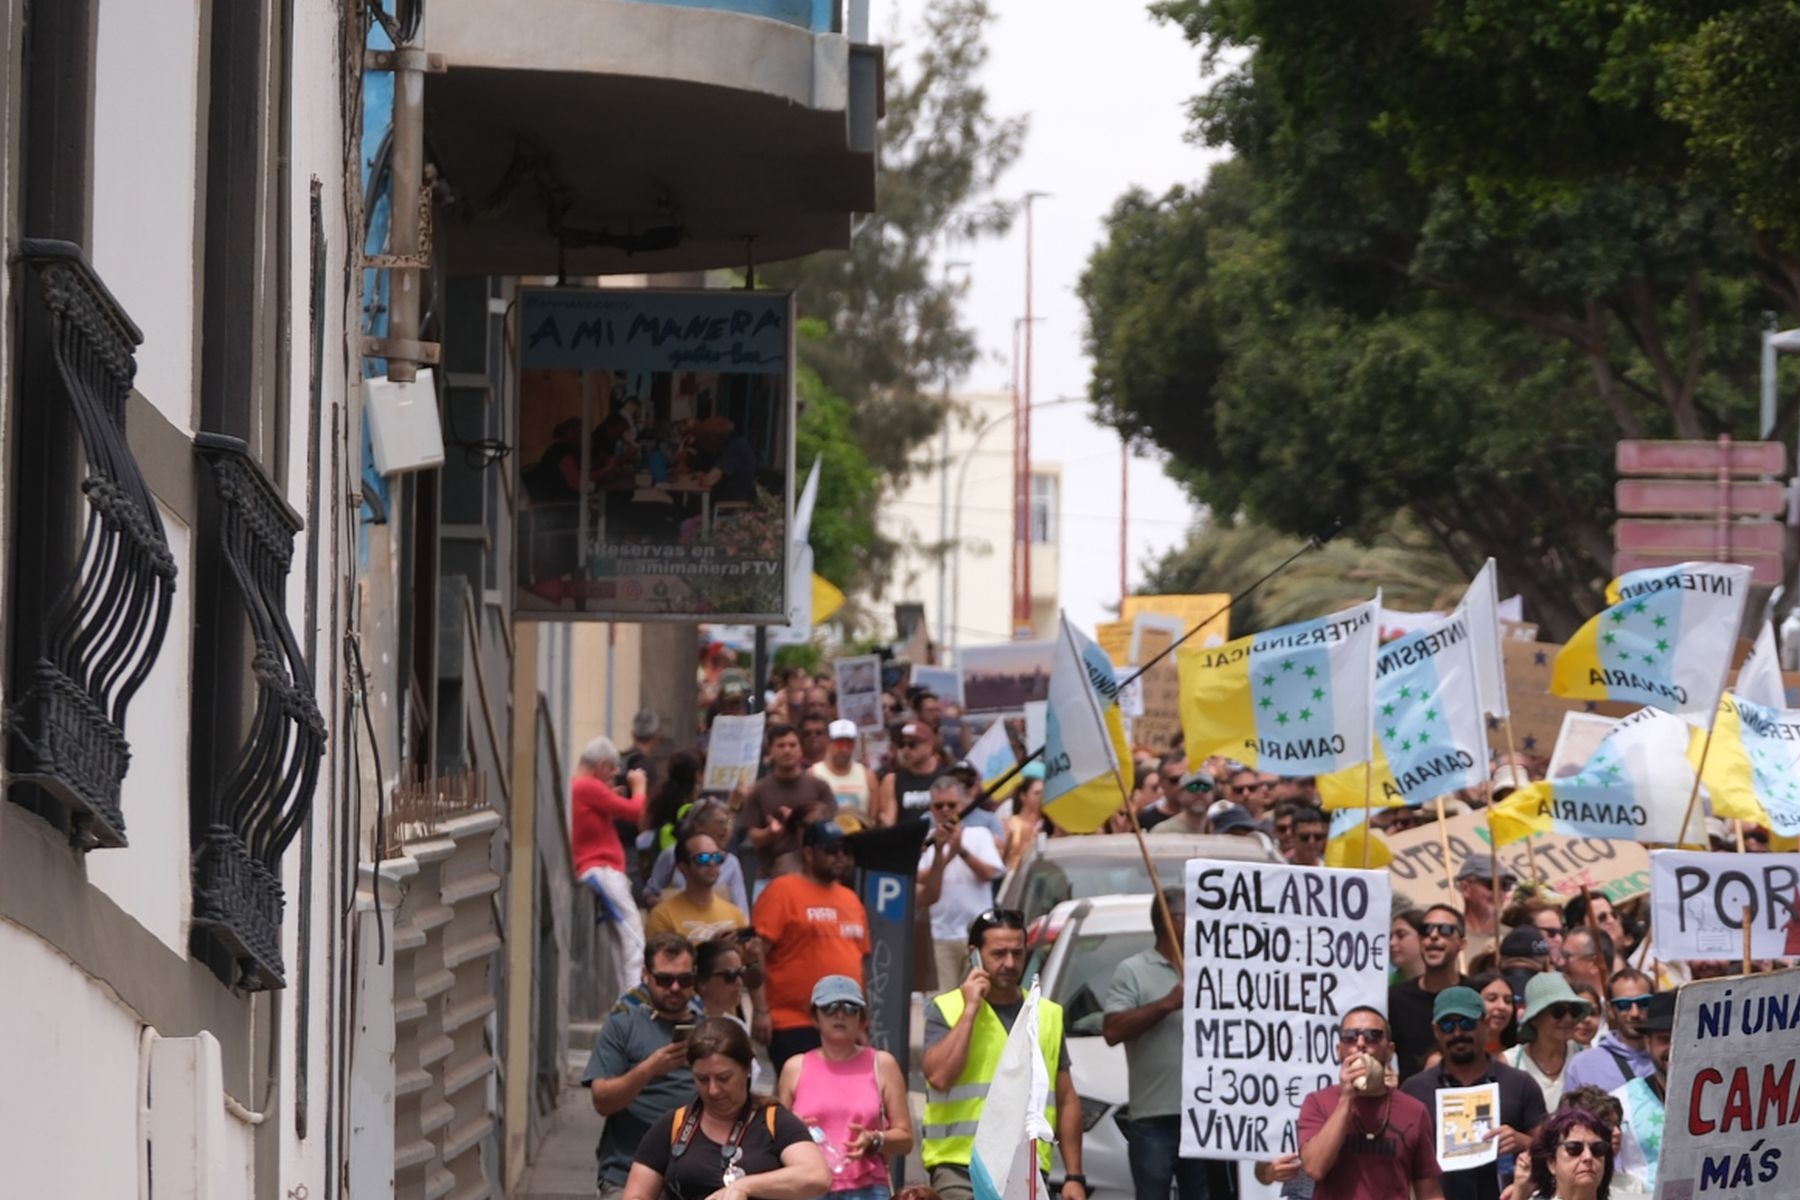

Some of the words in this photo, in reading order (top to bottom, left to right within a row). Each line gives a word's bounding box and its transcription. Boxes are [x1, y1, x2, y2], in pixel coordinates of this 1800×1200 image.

[626, 308, 783, 347] MANERA
[877, 877, 901, 913] P
[1196, 868, 1369, 921] SALARIO
[1675, 864, 1800, 933] POR
[1700, 1138, 1782, 1191] MÁS
